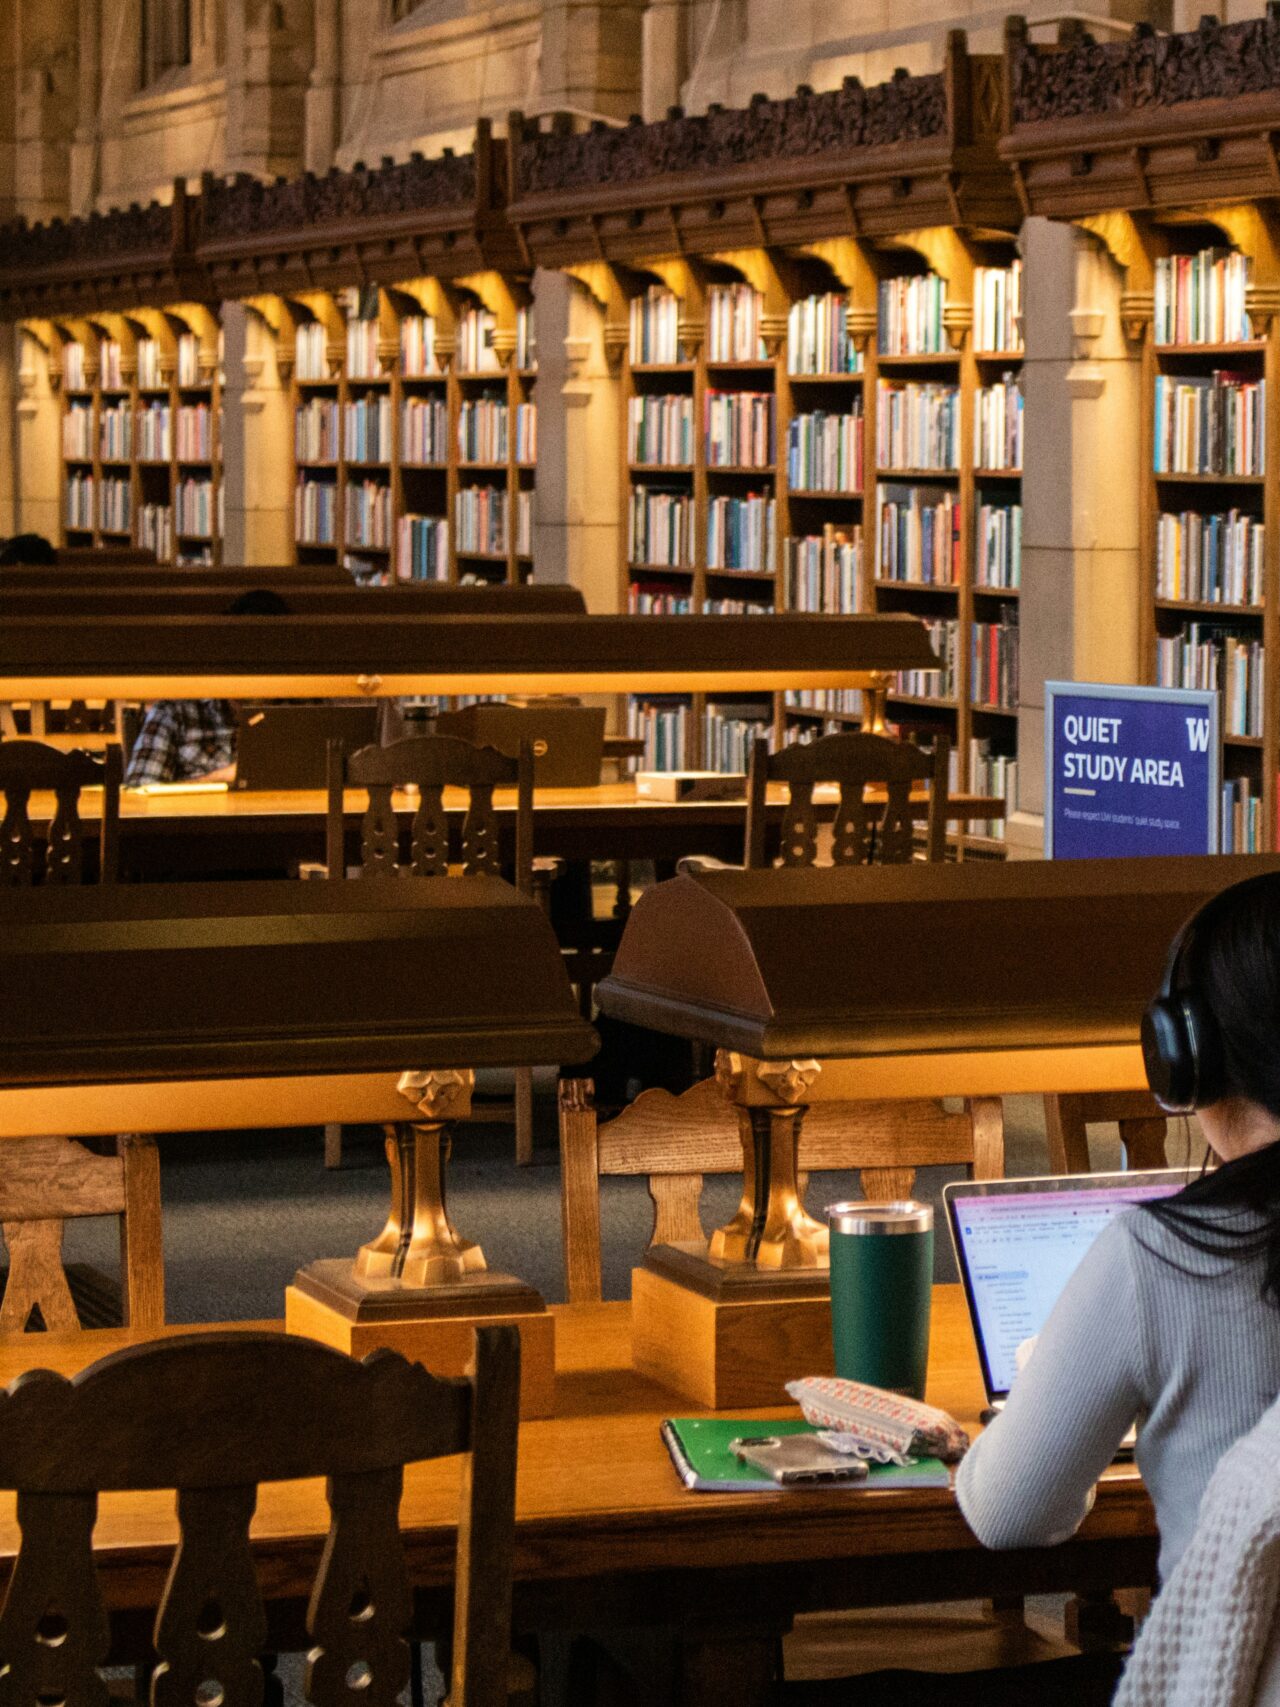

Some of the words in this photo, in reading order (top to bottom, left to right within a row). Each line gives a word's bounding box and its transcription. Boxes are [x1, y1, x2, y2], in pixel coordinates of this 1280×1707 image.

[1064, 715, 1122, 745] QUIET
[1186, 717, 1209, 752] W
[1064, 752, 1127, 782] STUDY
[1130, 758, 1184, 787] AREA
